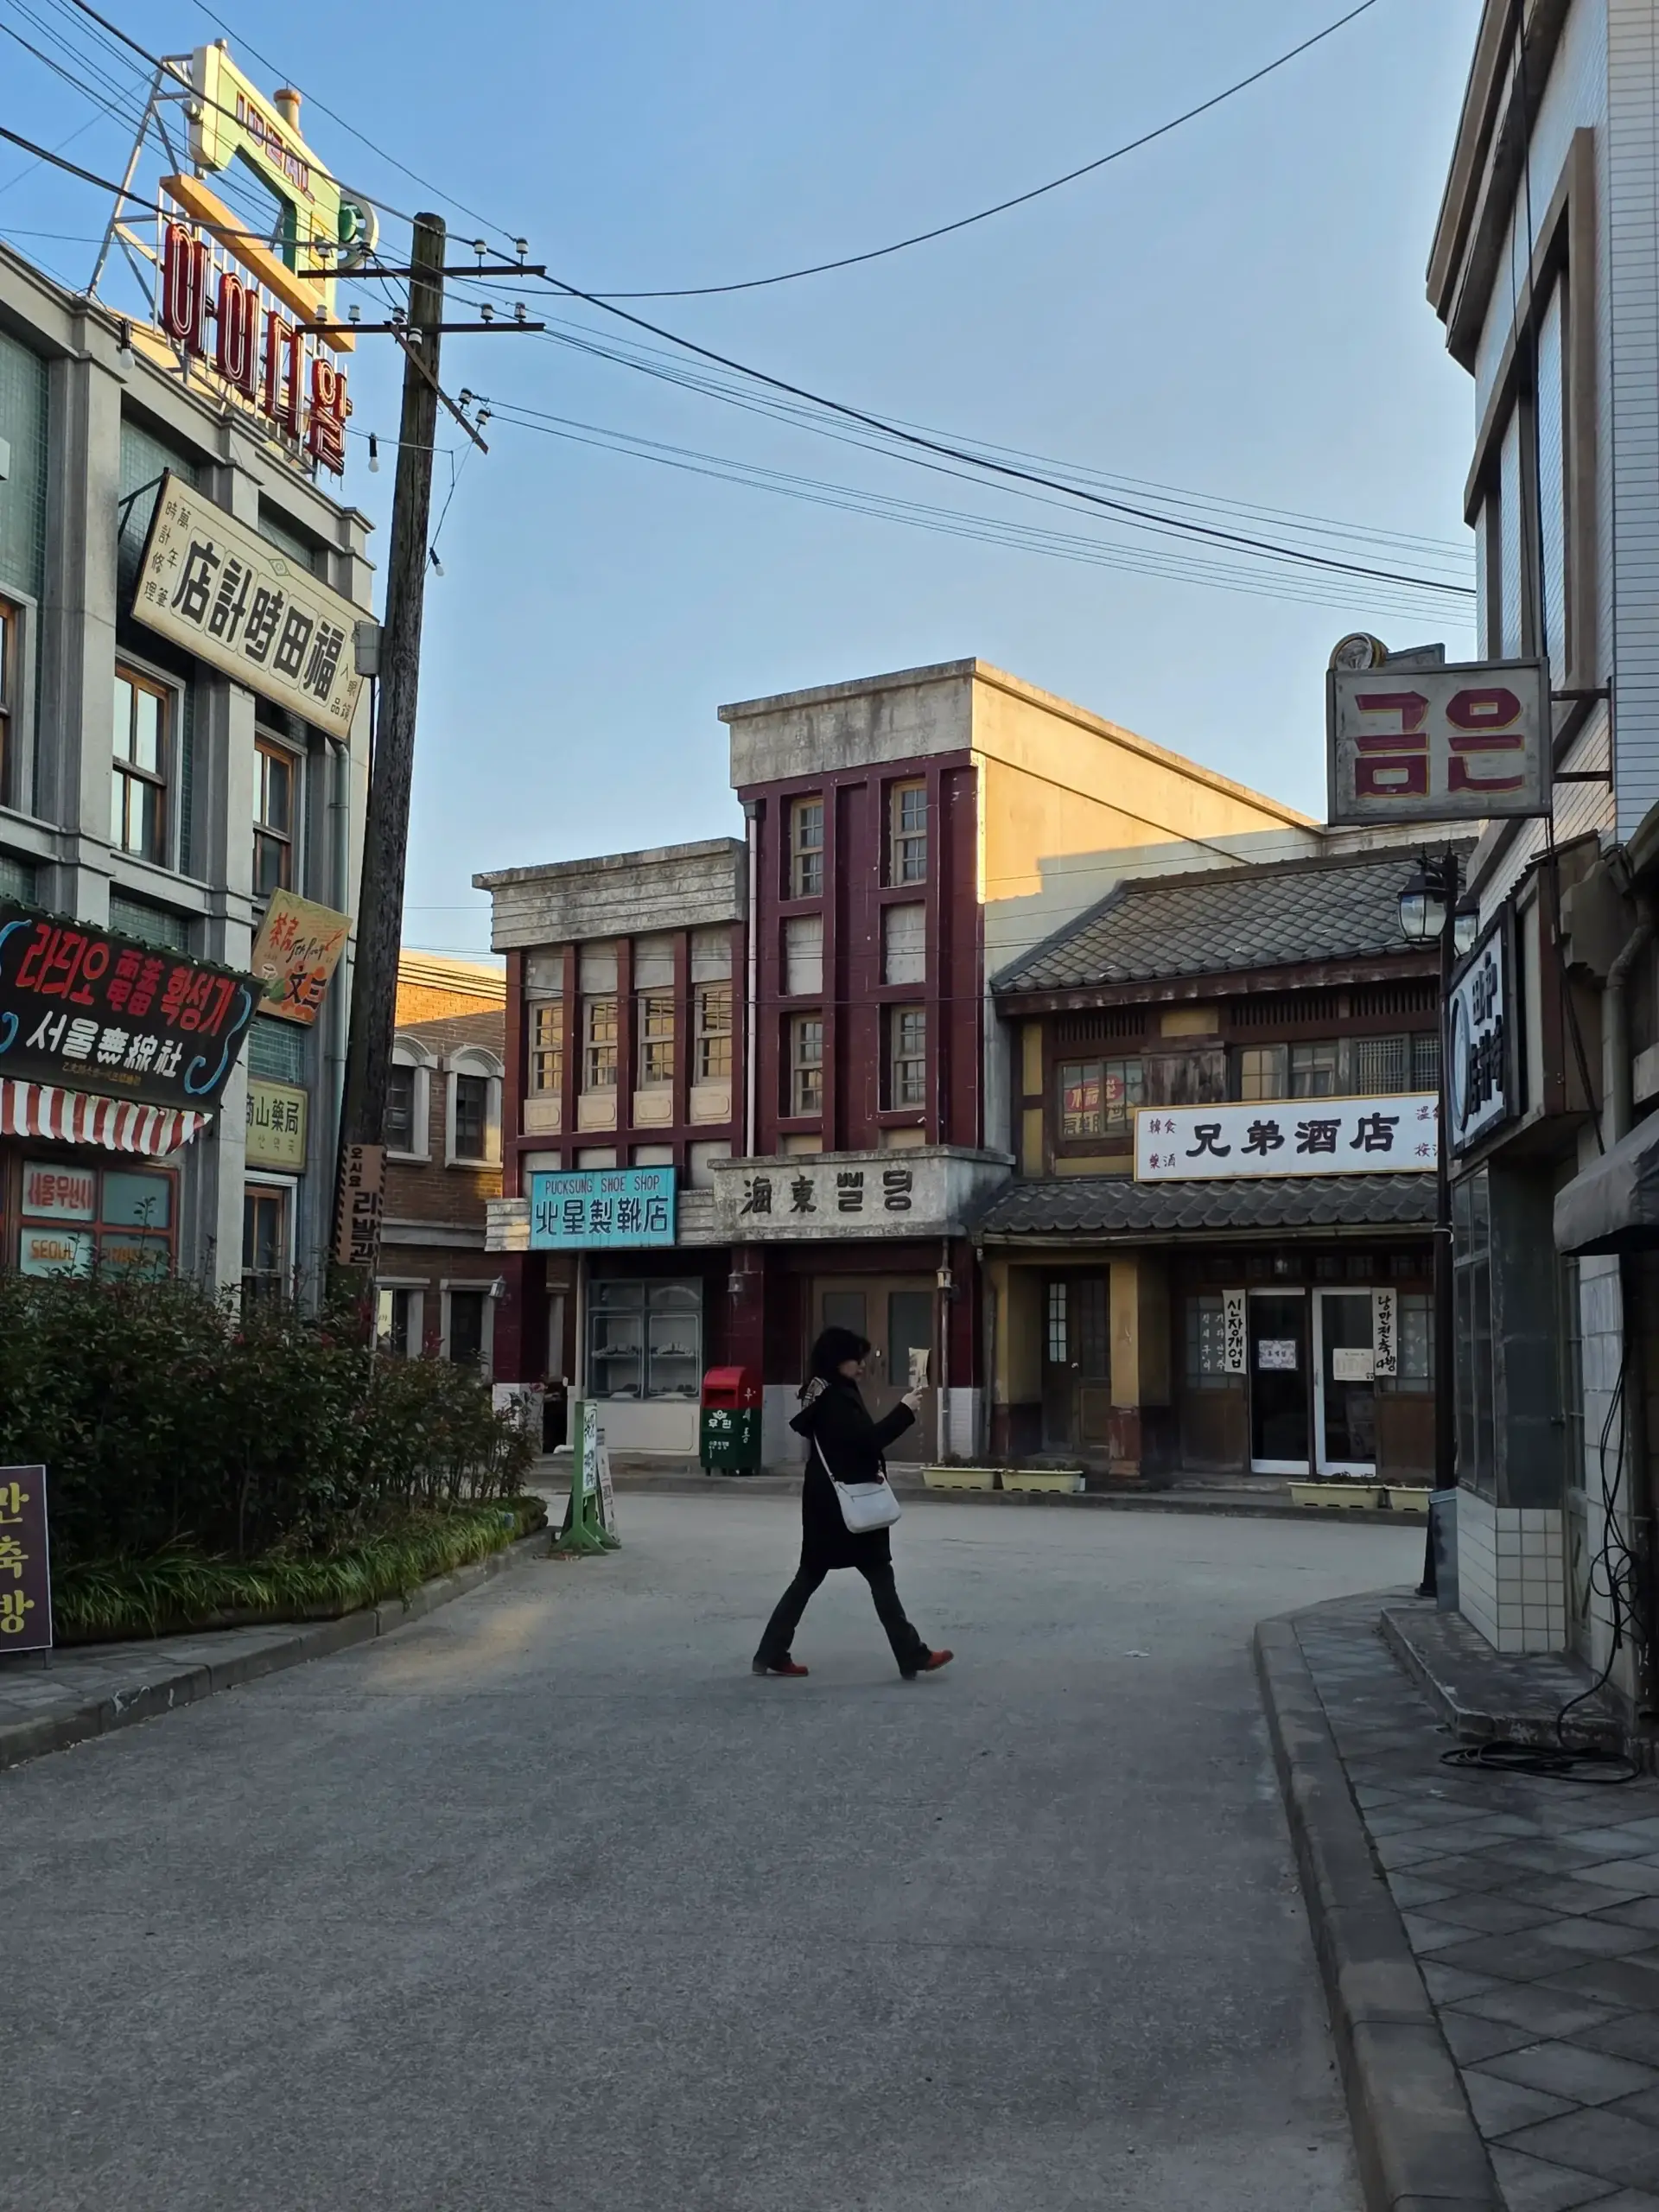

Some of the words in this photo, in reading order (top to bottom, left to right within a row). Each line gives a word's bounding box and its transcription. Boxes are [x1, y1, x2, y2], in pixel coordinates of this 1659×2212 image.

[236, 91, 315, 205] IDEAL
[1355, 688, 1525, 798] 금은
[15, 922, 110, 1006] 라디오
[160, 963, 237, 1037] 확성기
[1185, 1112, 1401, 1158] 兄弟酒店
[1414, 1142, 1438, 1158] 按
[545, 1178, 593, 1195] PUCKSUNG
[601, 1176, 626, 1192] SHOE
[634, 1175, 660, 1192] SHOP
[536, 1195, 668, 1236] 北星製靴店
[31, 1239, 74, 1261] SEOUL
[1228, 1298, 1243, 1368] 신장개업
